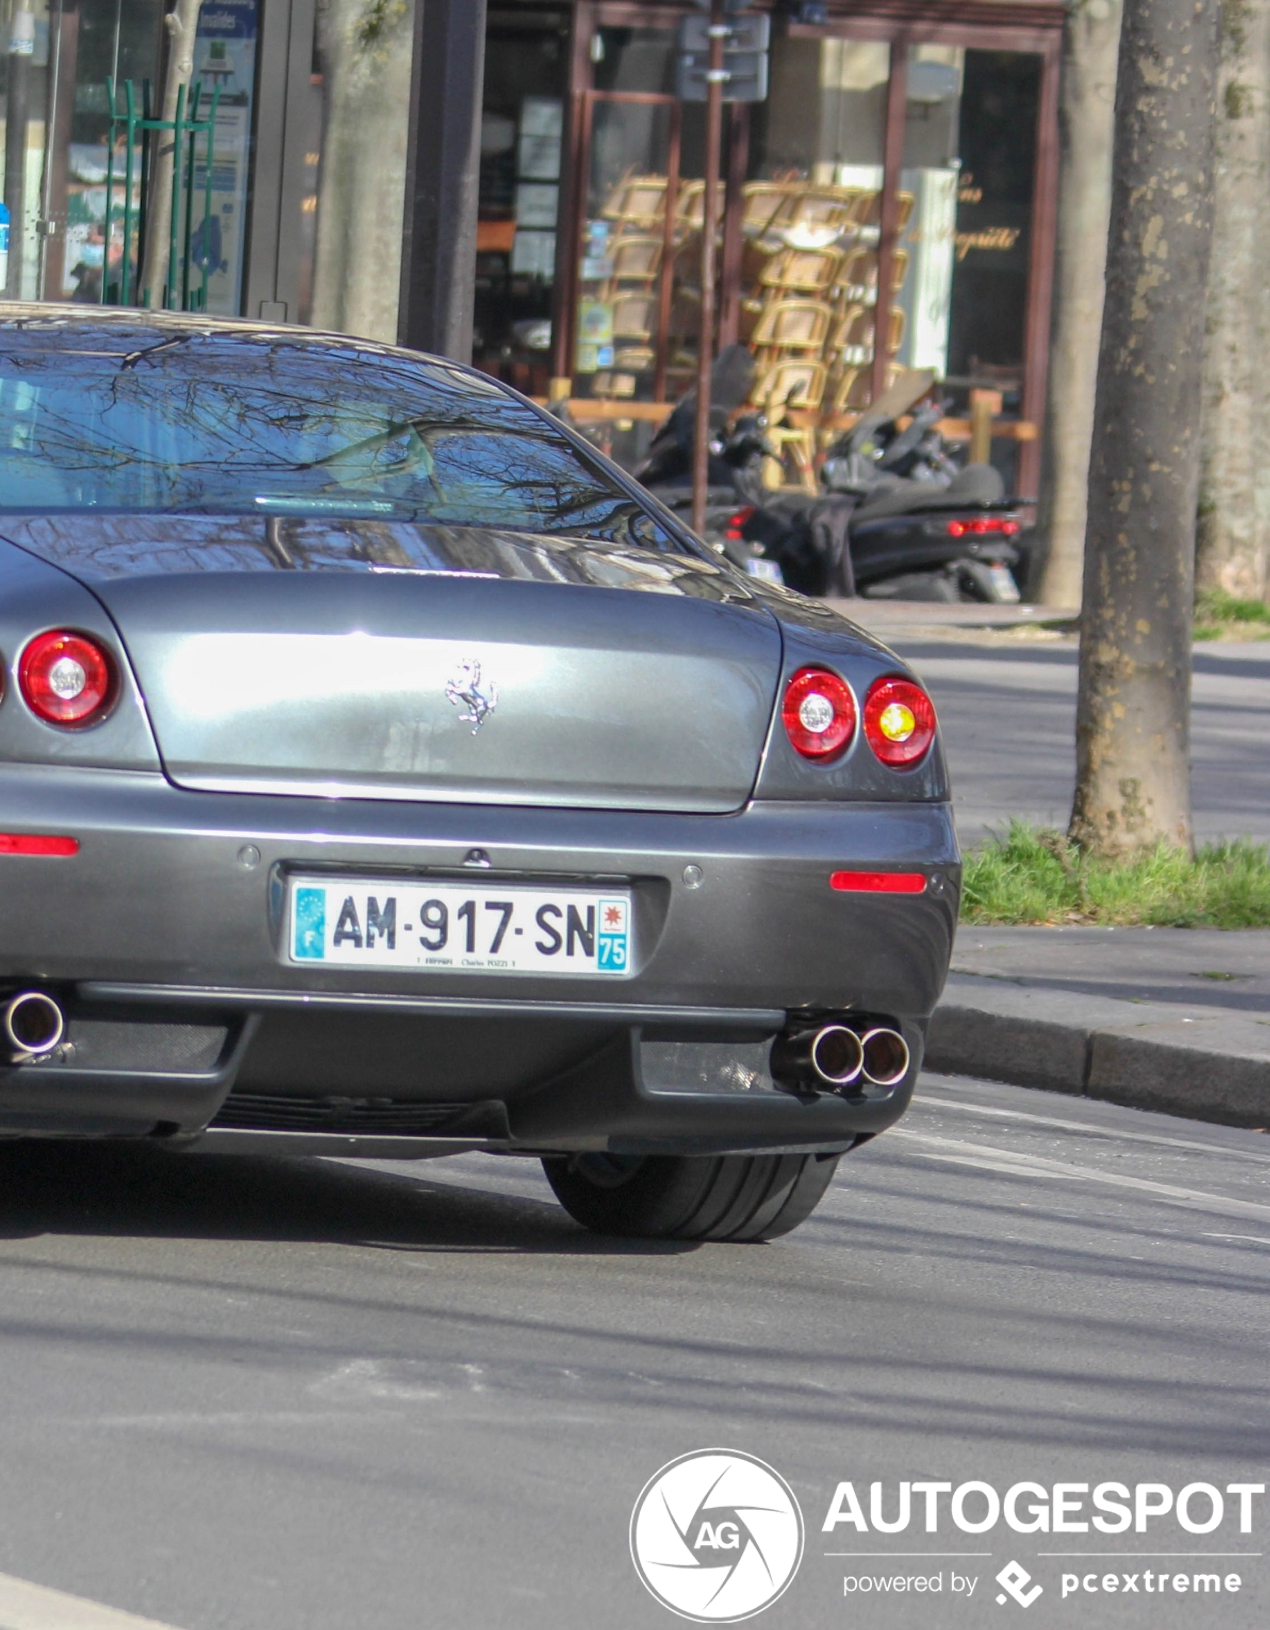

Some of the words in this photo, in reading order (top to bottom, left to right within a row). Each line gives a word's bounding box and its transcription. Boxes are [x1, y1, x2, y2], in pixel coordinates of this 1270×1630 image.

[304, 930, 316, 947] F
[333, 895, 595, 957] AM-917-SN
[600, 938, 625, 964] 75
